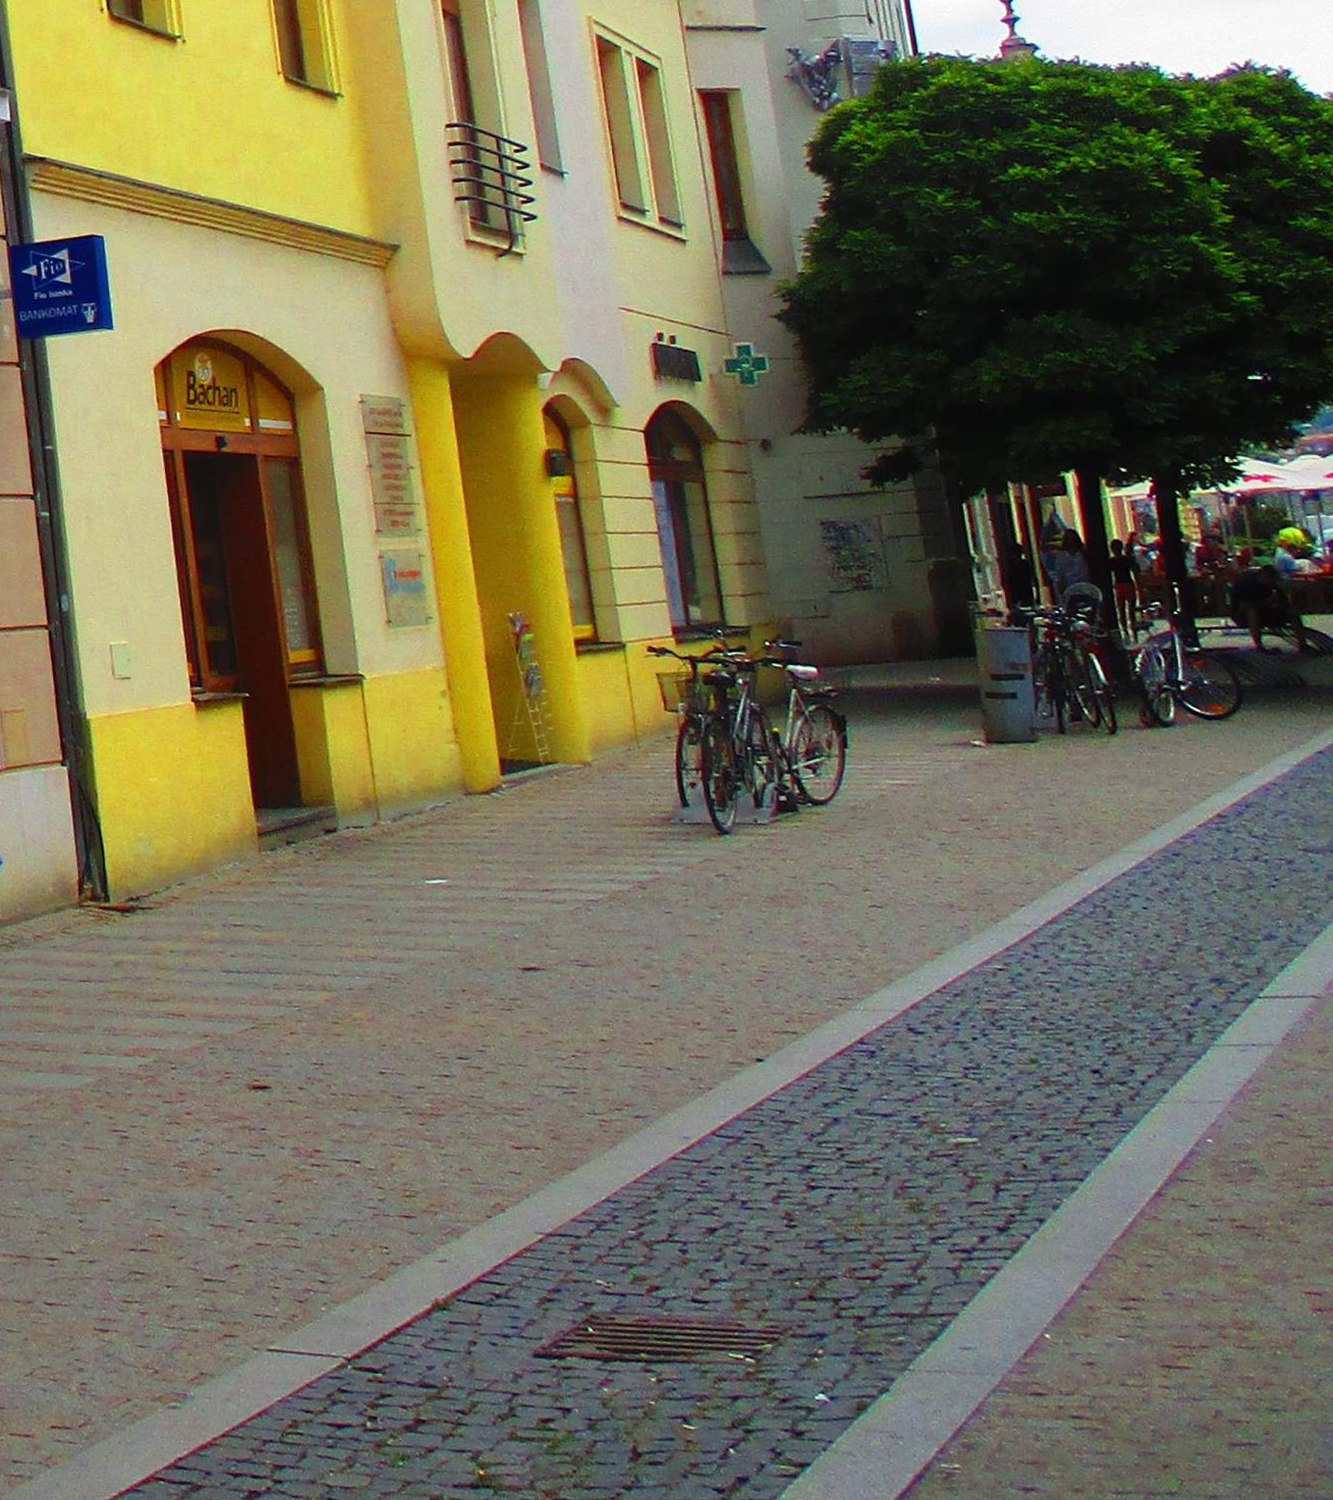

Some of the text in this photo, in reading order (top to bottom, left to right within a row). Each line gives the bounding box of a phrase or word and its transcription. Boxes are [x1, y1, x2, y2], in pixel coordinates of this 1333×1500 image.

[38, 258, 64, 280] Fio
[19, 304, 79, 322] BANKOMAT
[186, 370, 239, 408] Bachan
